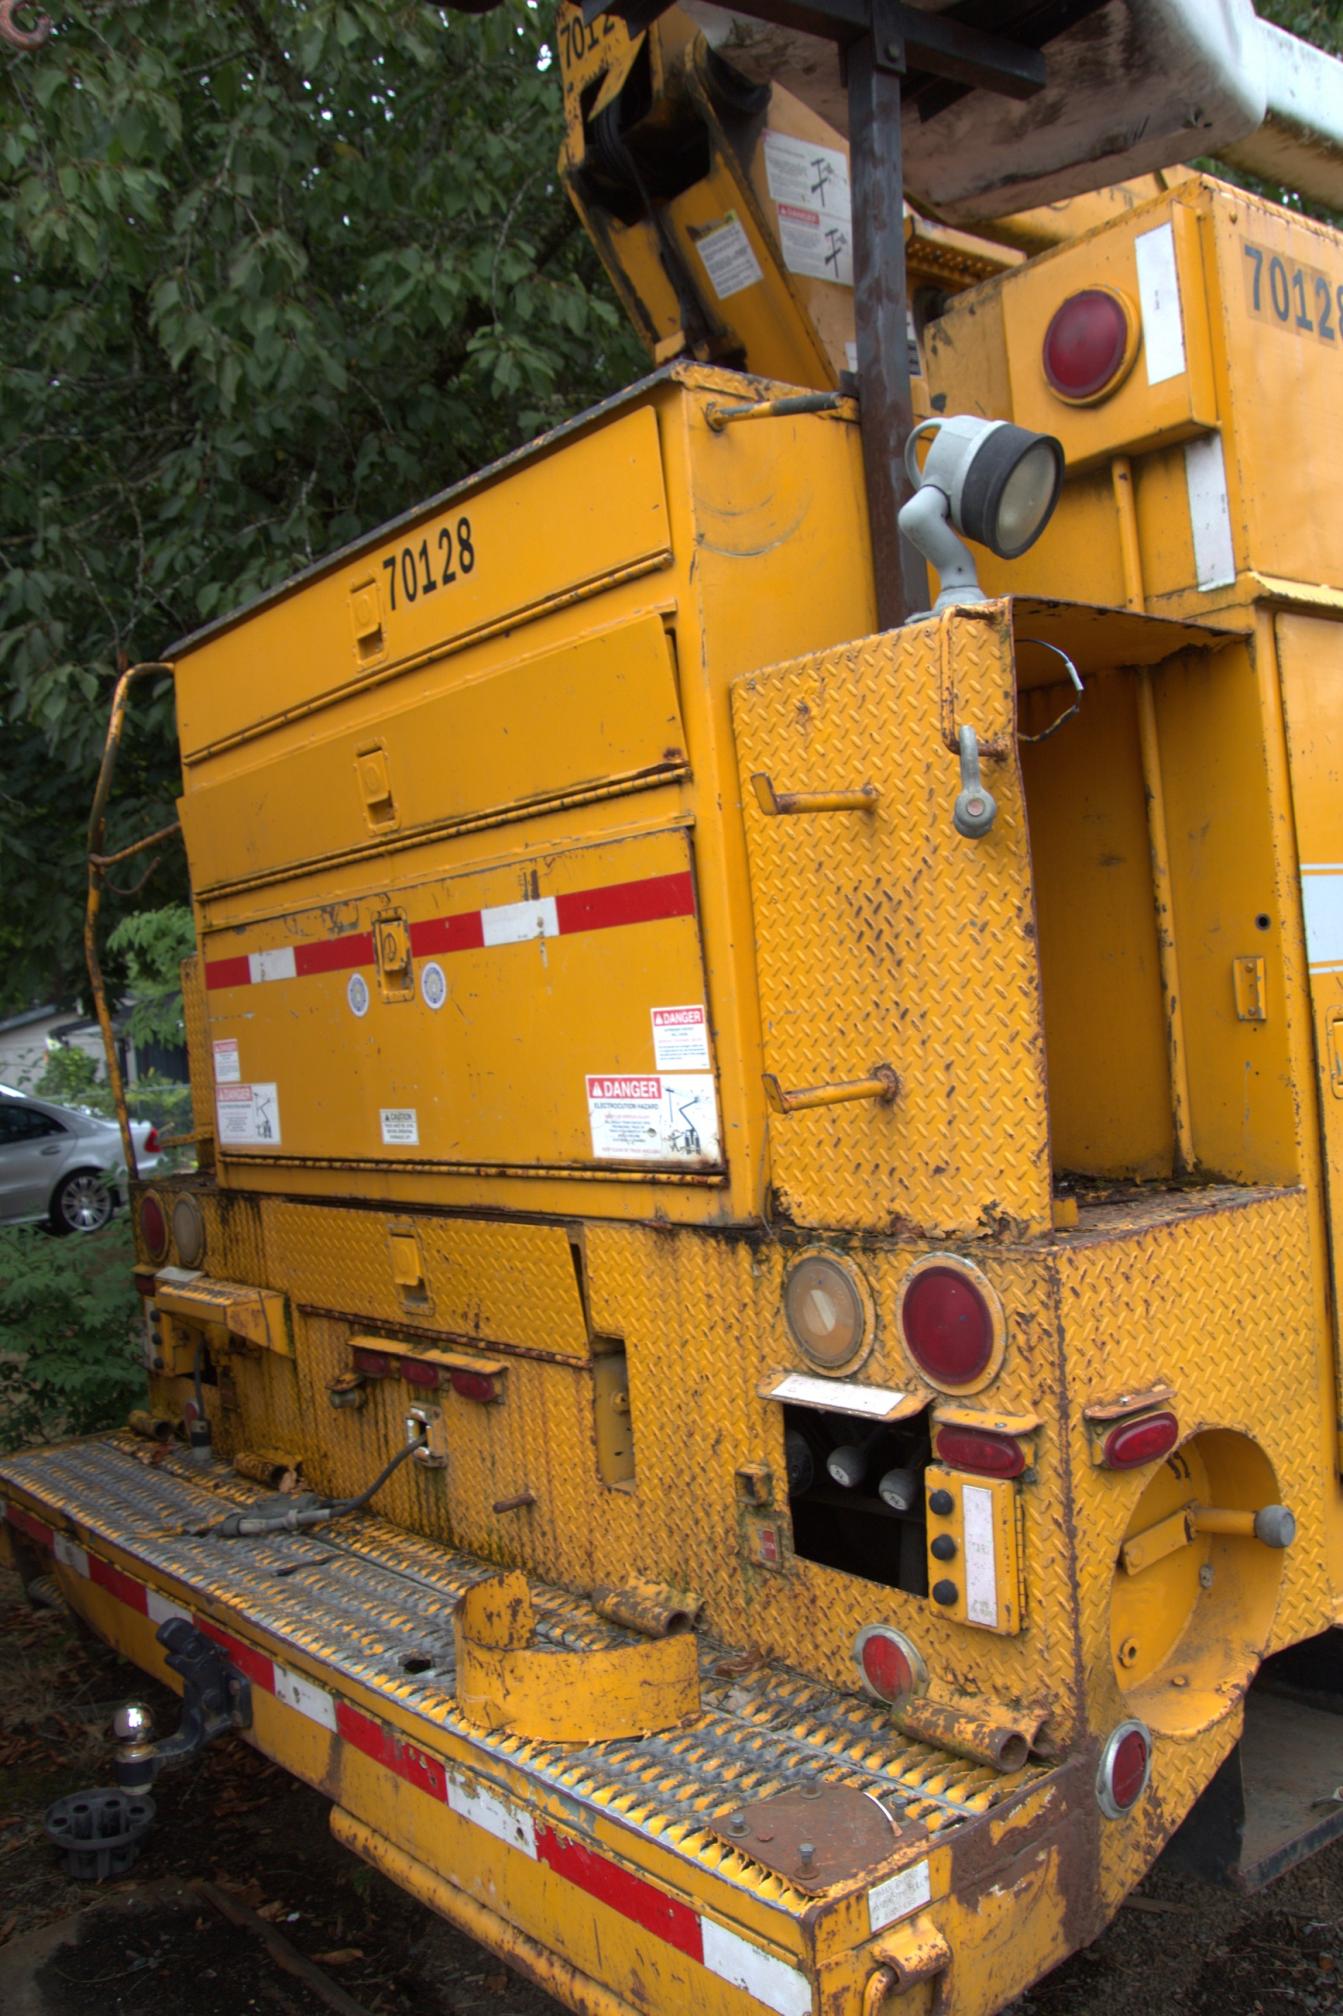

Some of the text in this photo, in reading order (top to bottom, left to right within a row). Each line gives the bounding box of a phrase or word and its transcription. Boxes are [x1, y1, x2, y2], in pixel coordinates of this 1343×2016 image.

[383, 516, 475, 611] 70128
[663, 1010, 701, 1024] DANGER
[603, 1081, 659, 1098] DANGER
